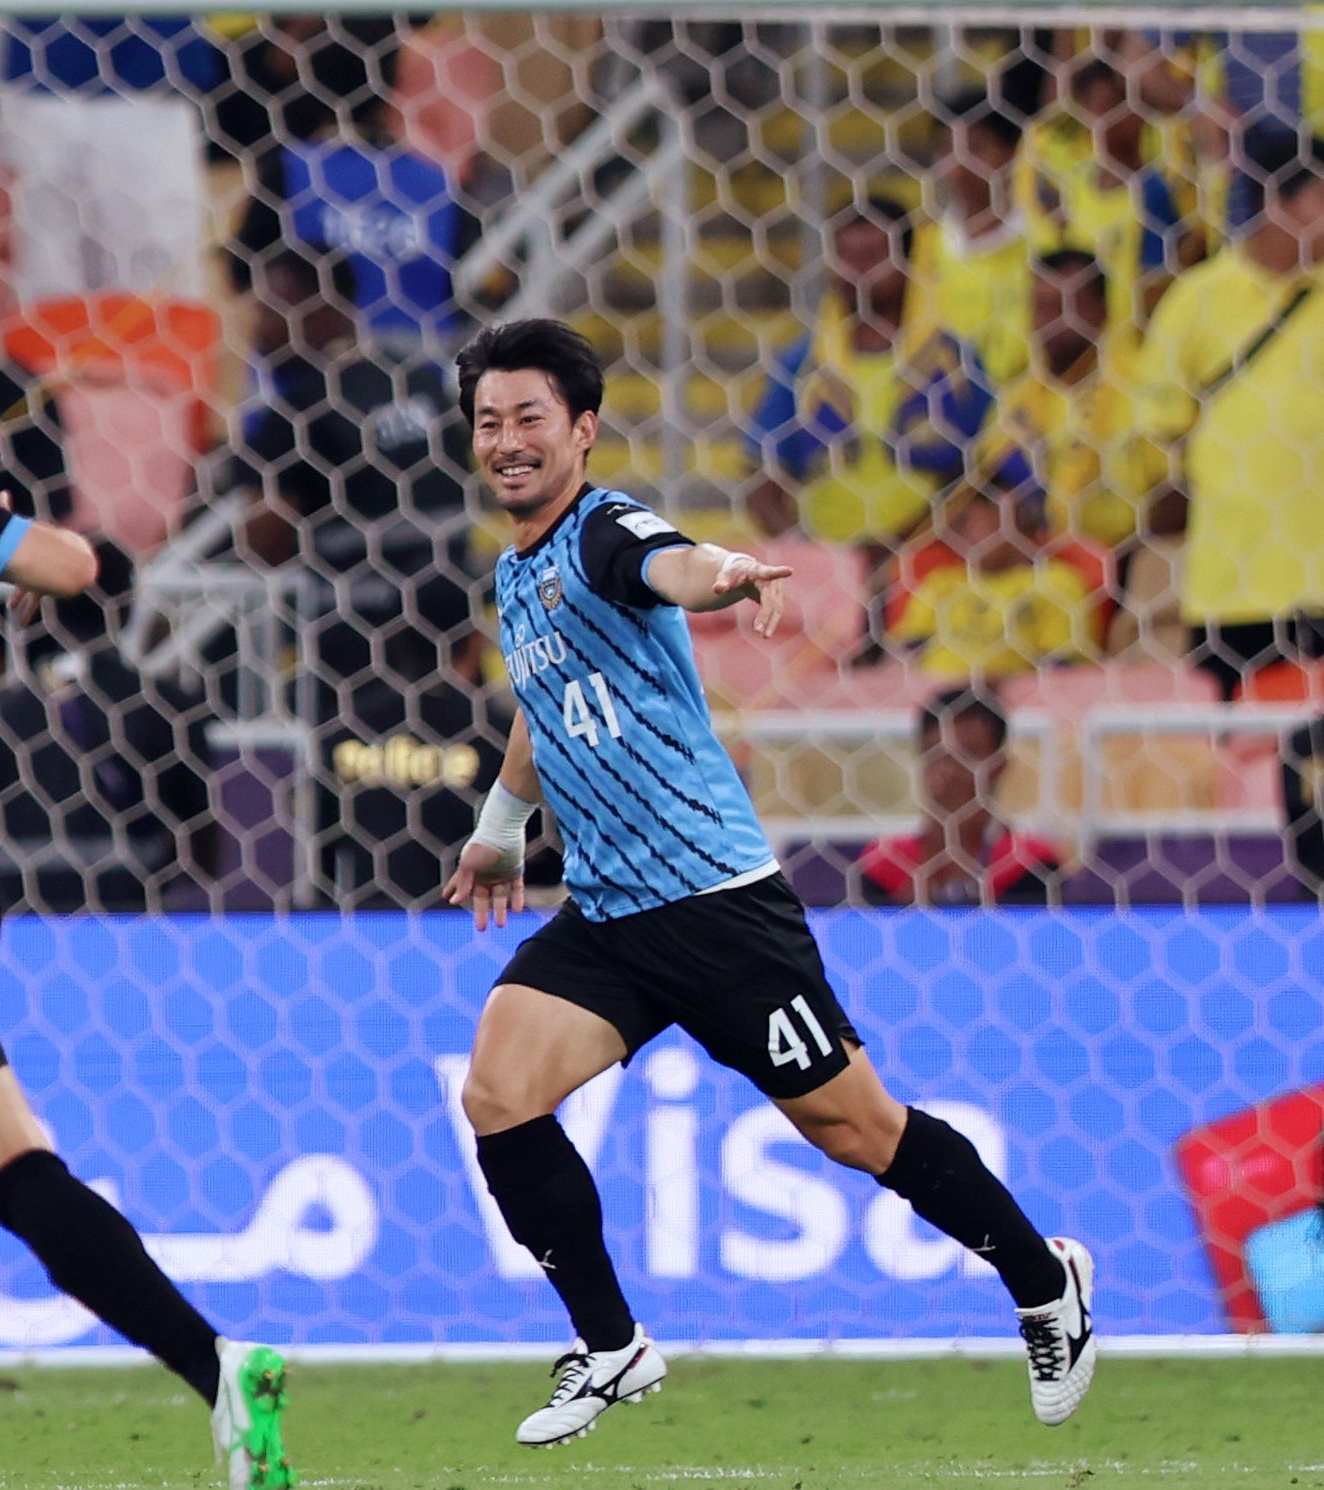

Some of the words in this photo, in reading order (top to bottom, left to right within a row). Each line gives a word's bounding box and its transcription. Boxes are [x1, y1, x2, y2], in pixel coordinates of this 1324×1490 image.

[563, 671, 622, 747] 41
[767, 994, 834, 1071] 41
[434, 1047, 1007, 1281] Visa
